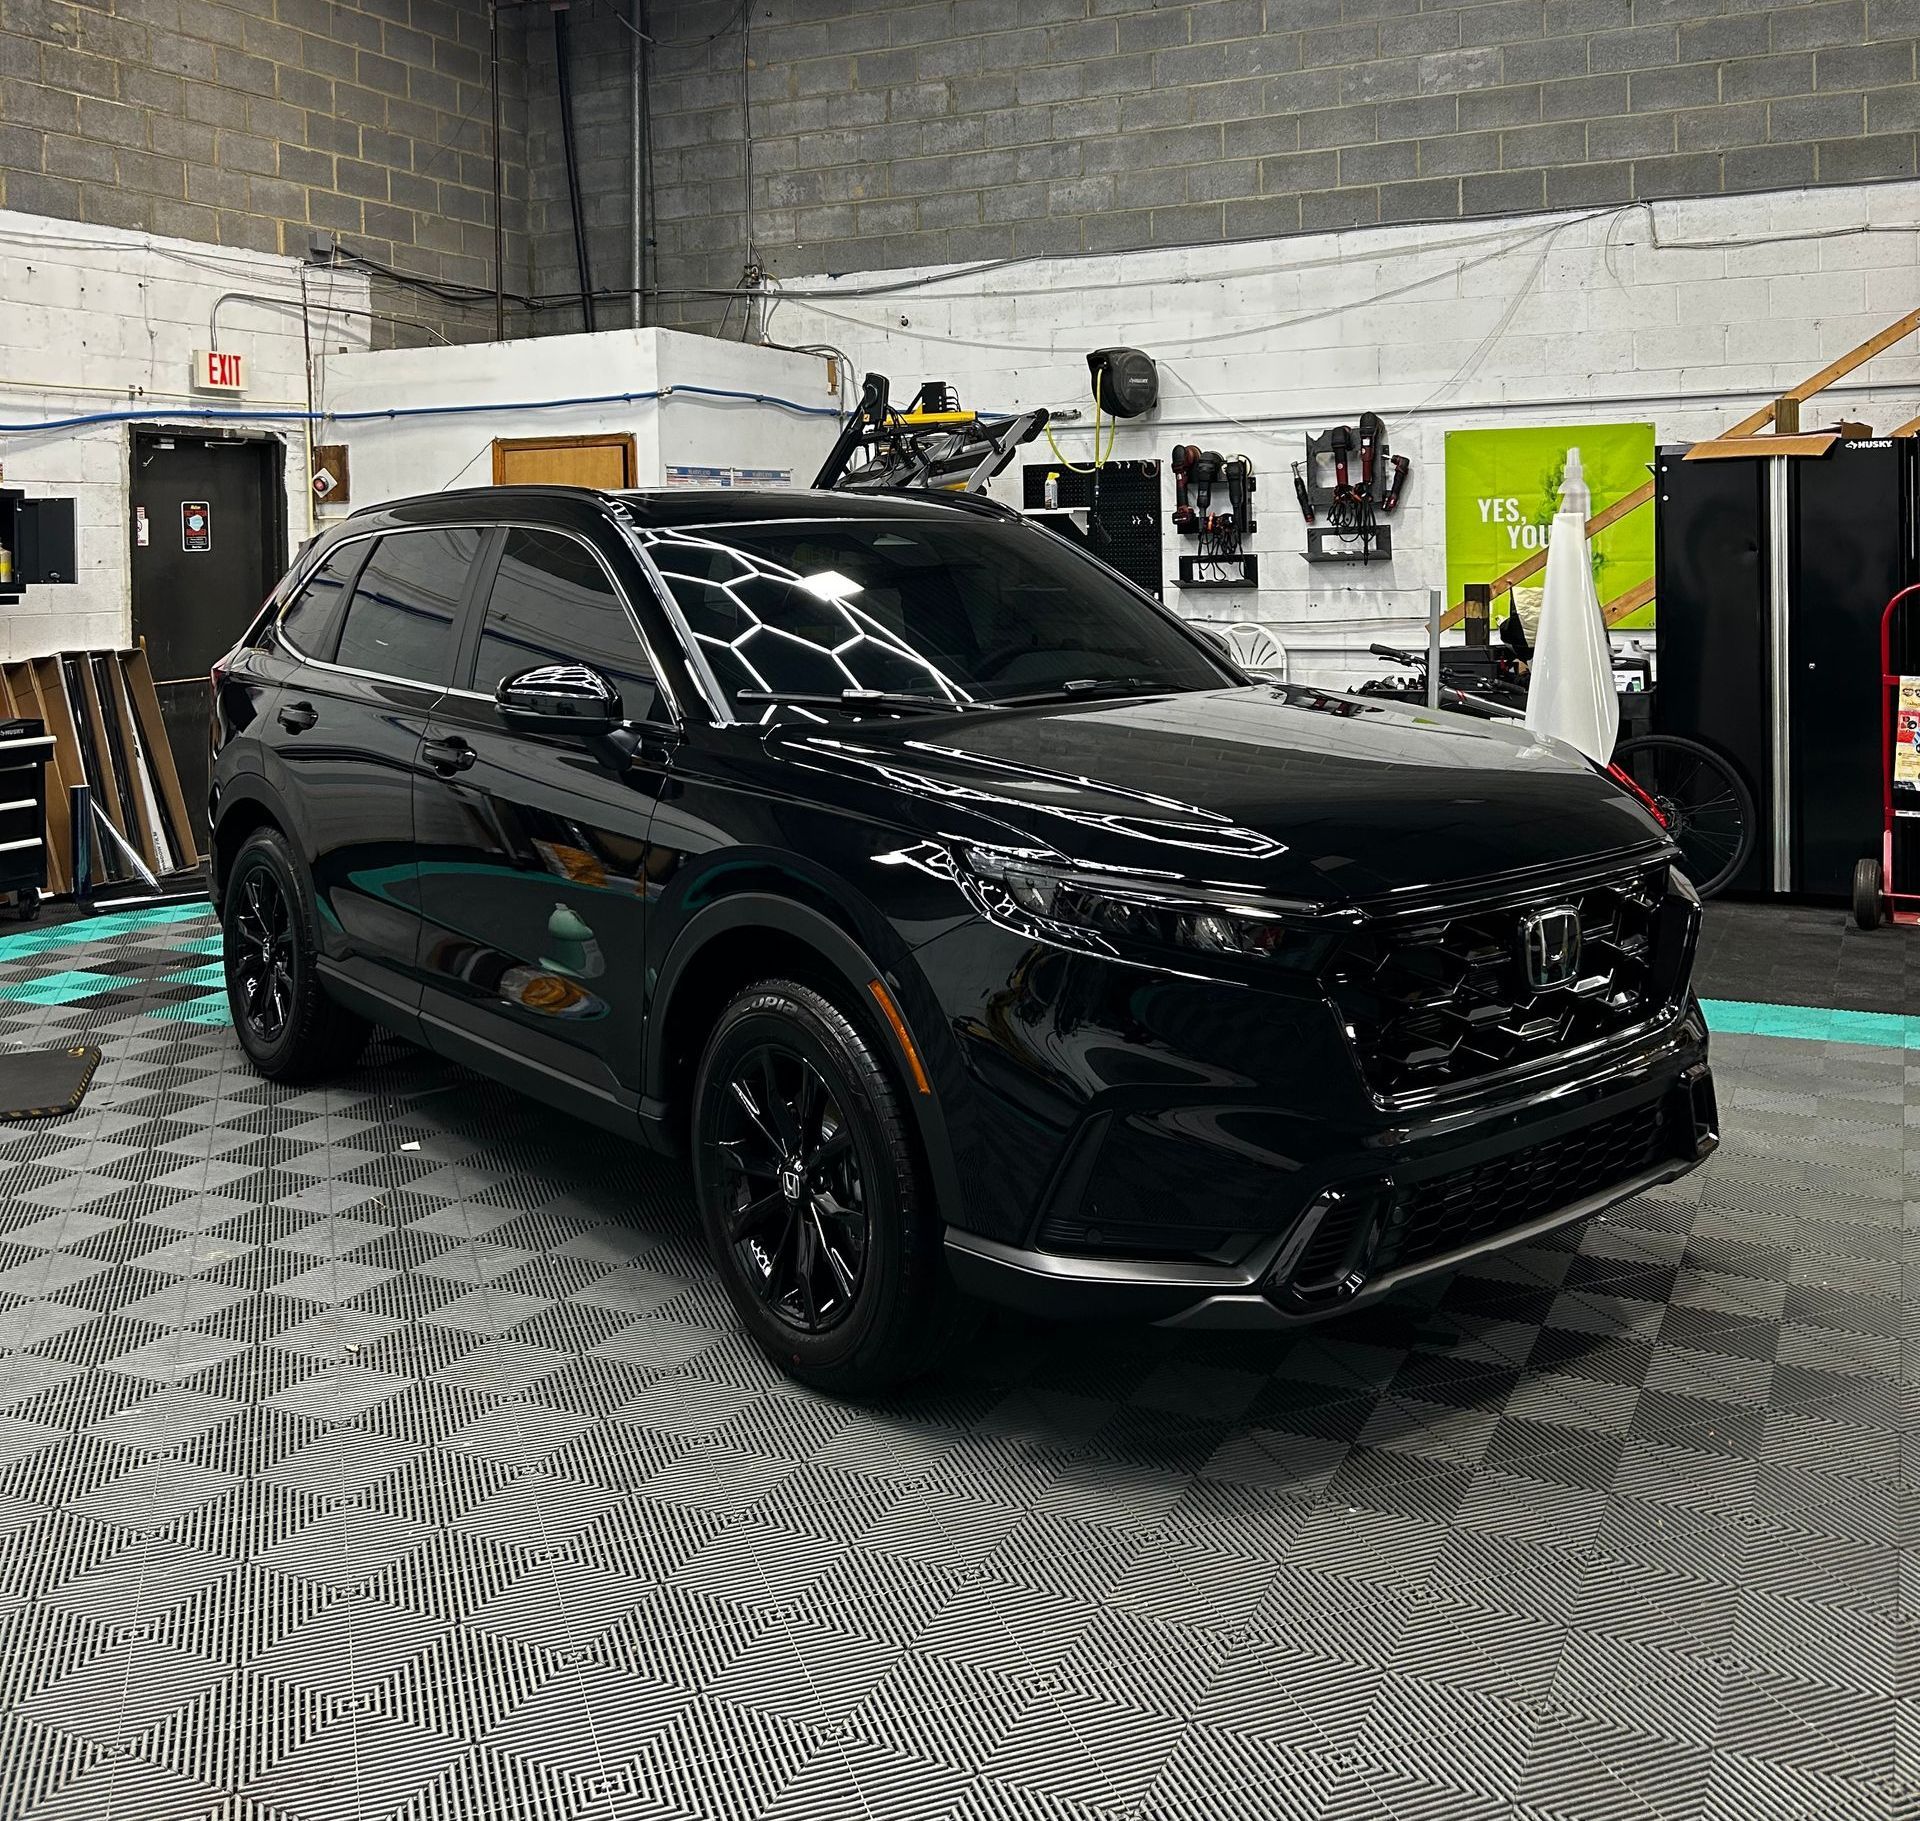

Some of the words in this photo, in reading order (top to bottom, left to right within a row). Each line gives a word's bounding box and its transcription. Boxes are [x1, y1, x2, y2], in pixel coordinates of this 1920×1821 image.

[208, 353, 241, 386] EXIT
[1858, 440, 1893, 449] HUSKY
[1477, 498, 1527, 525] YES,
[1507, 524, 1552, 549] YOU
